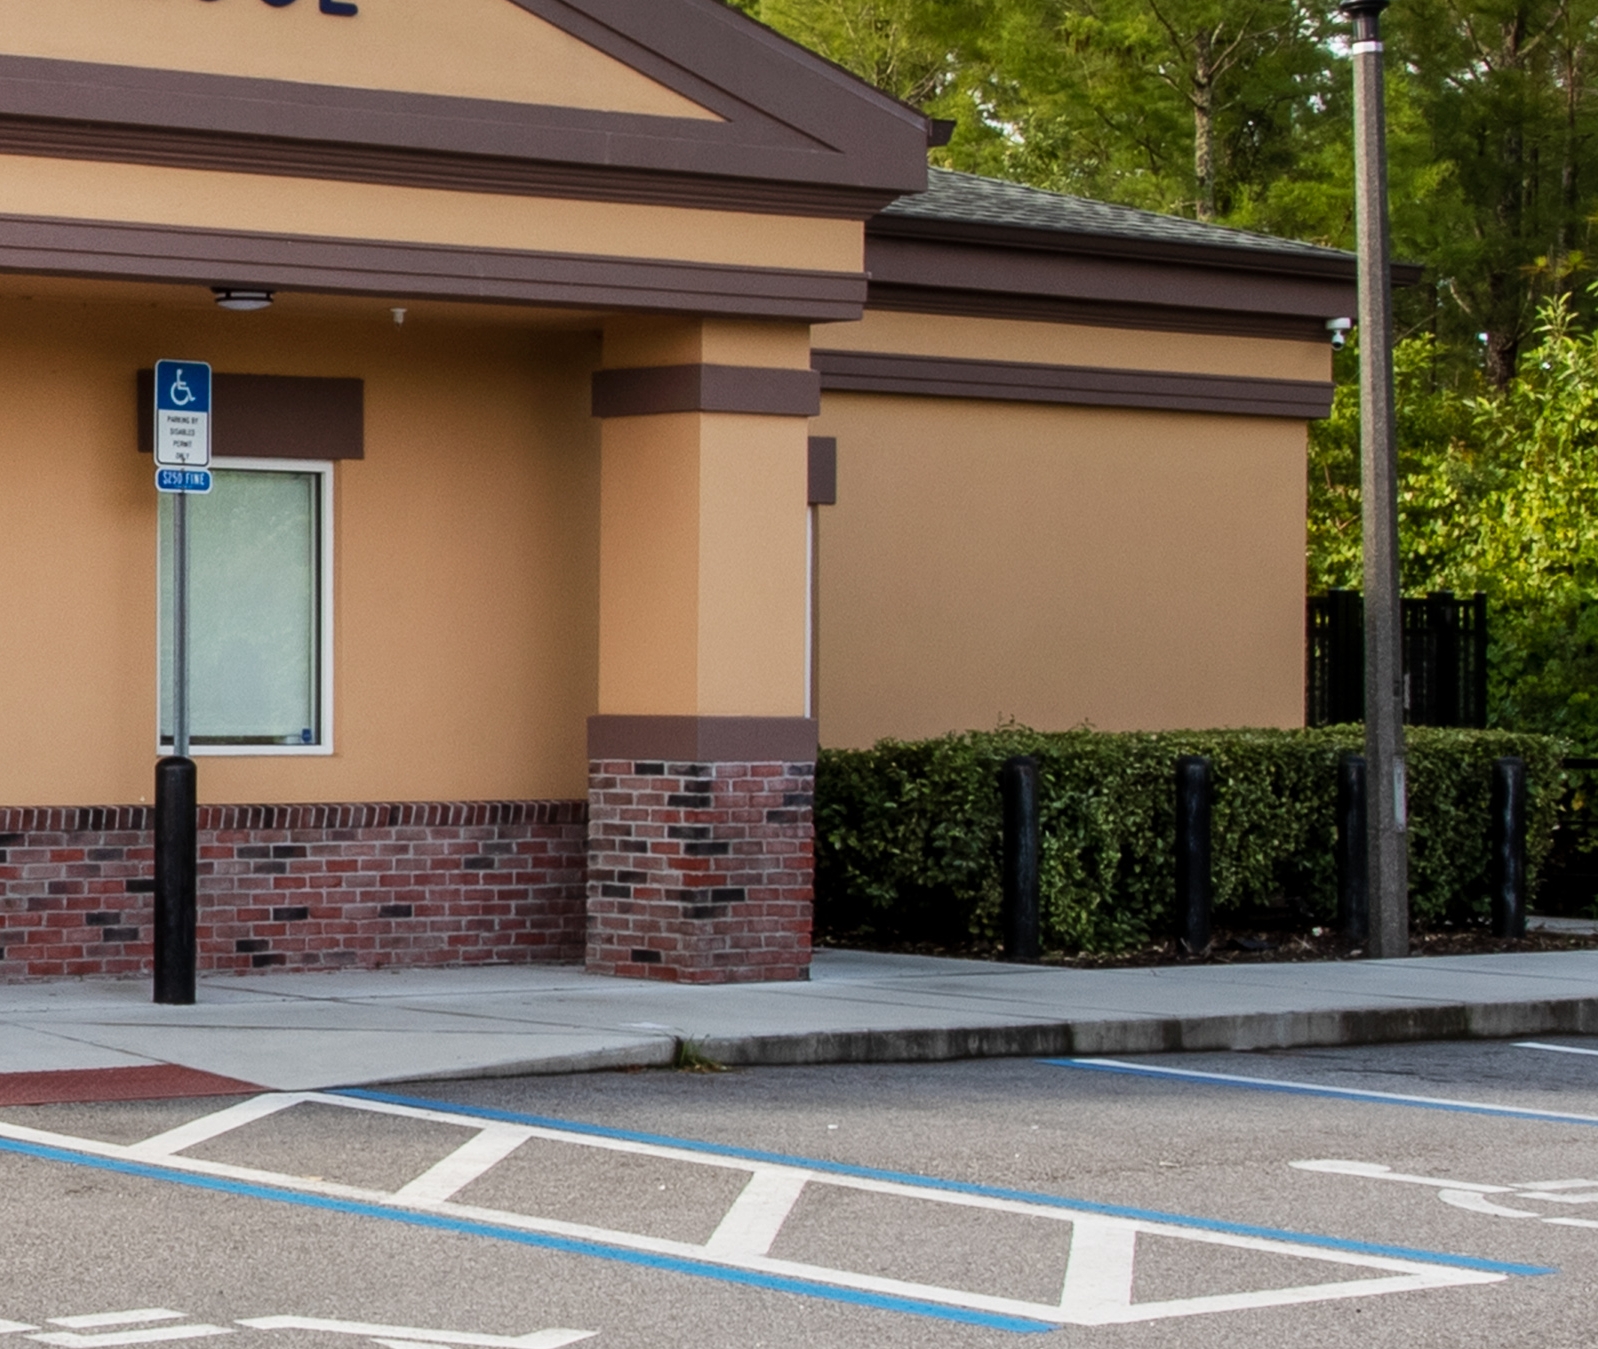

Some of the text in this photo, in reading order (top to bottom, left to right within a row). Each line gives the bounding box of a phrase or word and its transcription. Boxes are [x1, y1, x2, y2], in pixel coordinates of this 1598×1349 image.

[167, 415, 190, 424] PARKING
[162, 471, 205, 486] $250 FINE
